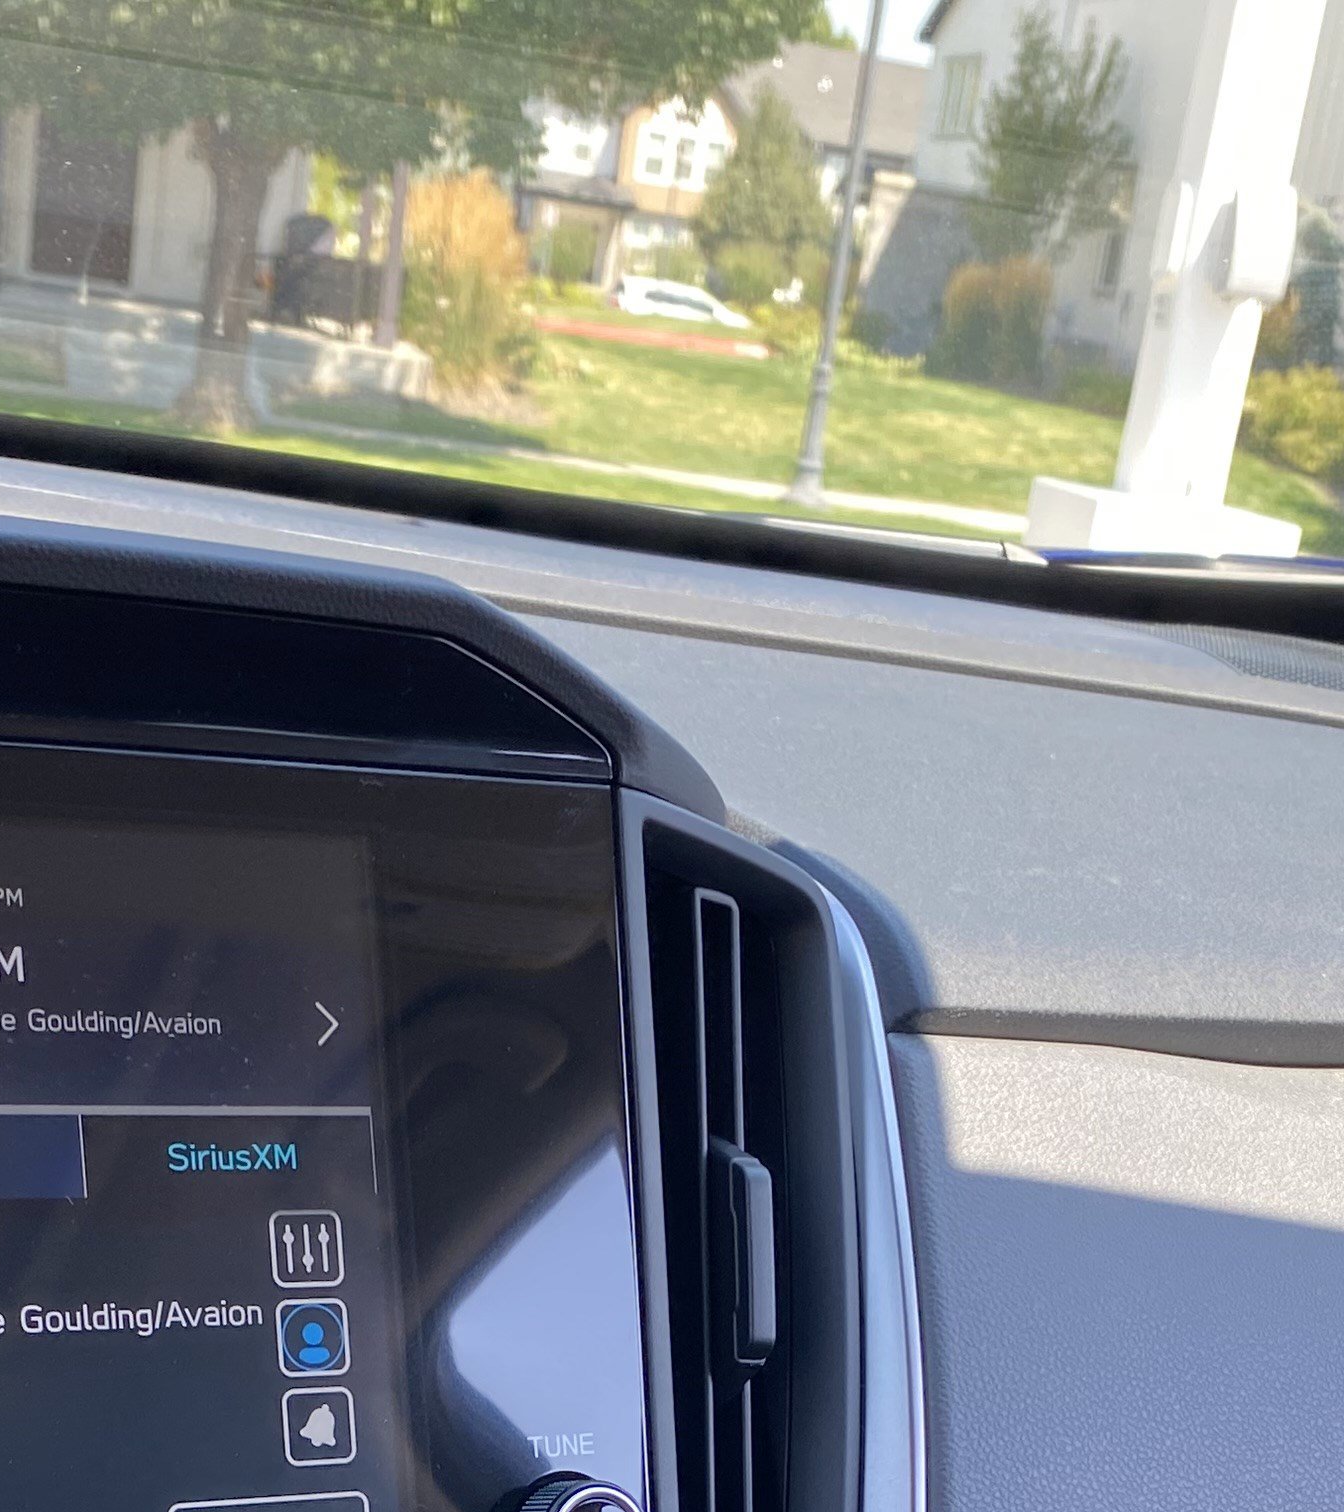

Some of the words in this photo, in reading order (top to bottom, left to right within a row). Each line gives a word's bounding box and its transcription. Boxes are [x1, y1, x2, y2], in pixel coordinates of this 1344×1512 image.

[27, 1008, 221, 1039] Goulding/Avaion
[168, 1143, 297, 1171] SiriusXM
[20, 1299, 263, 1337] Goulding/Avaion
[526, 1432, 595, 1458] TUNE
